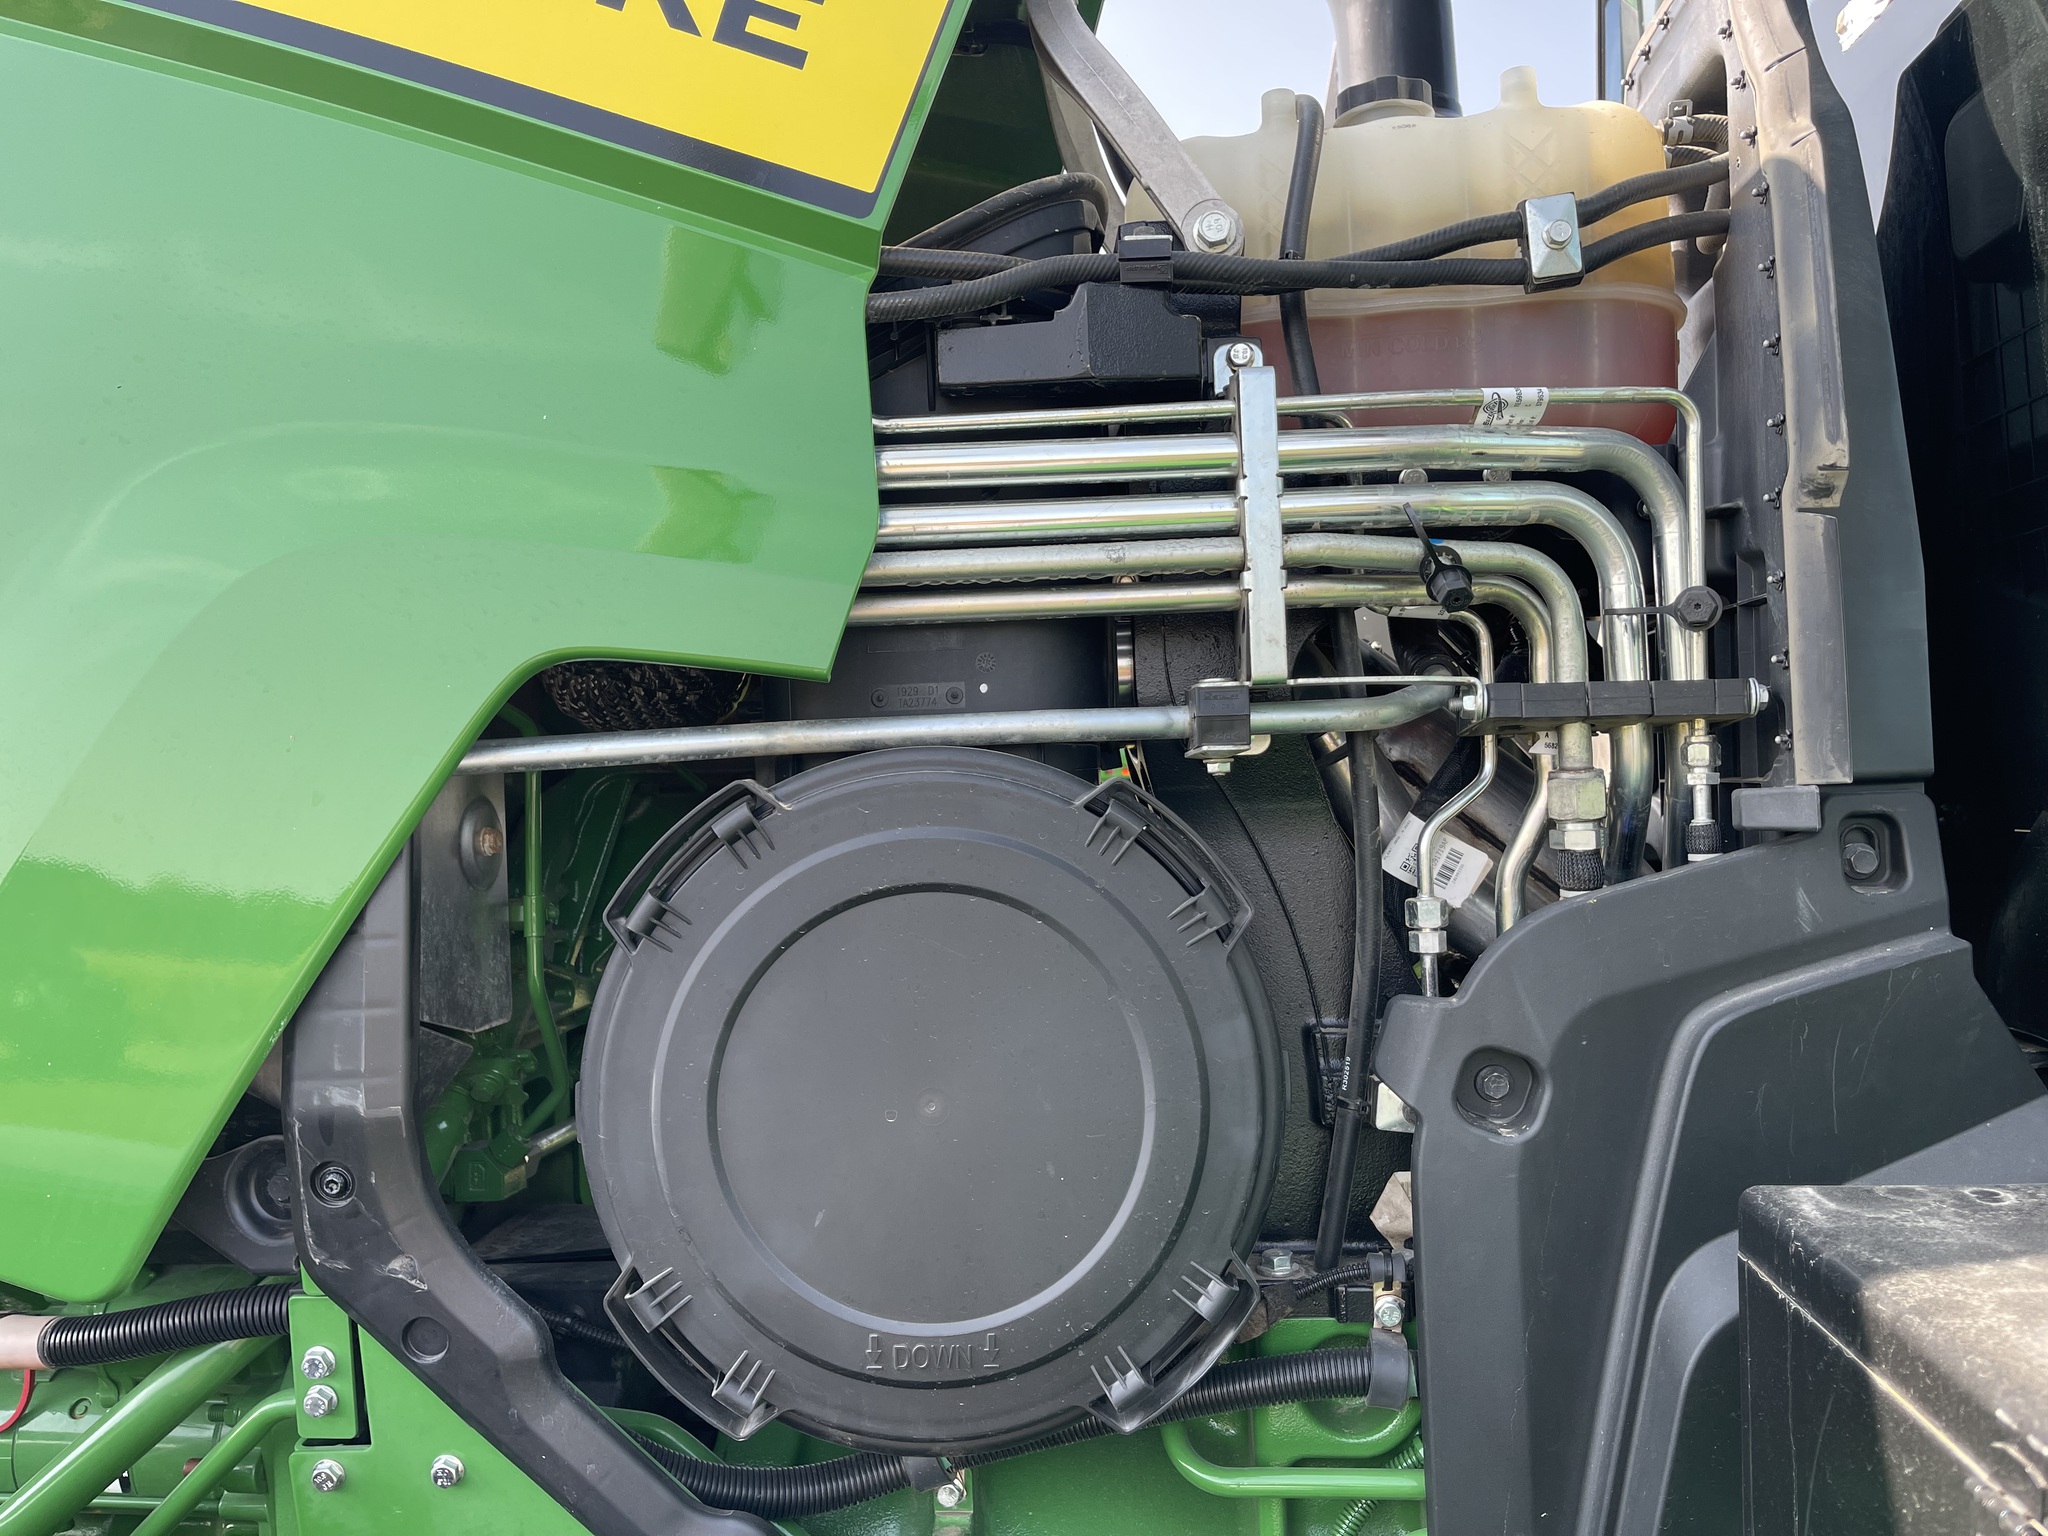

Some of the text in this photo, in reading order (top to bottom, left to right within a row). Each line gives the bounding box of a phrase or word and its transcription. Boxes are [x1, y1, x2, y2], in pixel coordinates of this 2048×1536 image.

[896, 685, 939, 698] 1929 D1
[892, 1344, 973, 1370] DOWN
